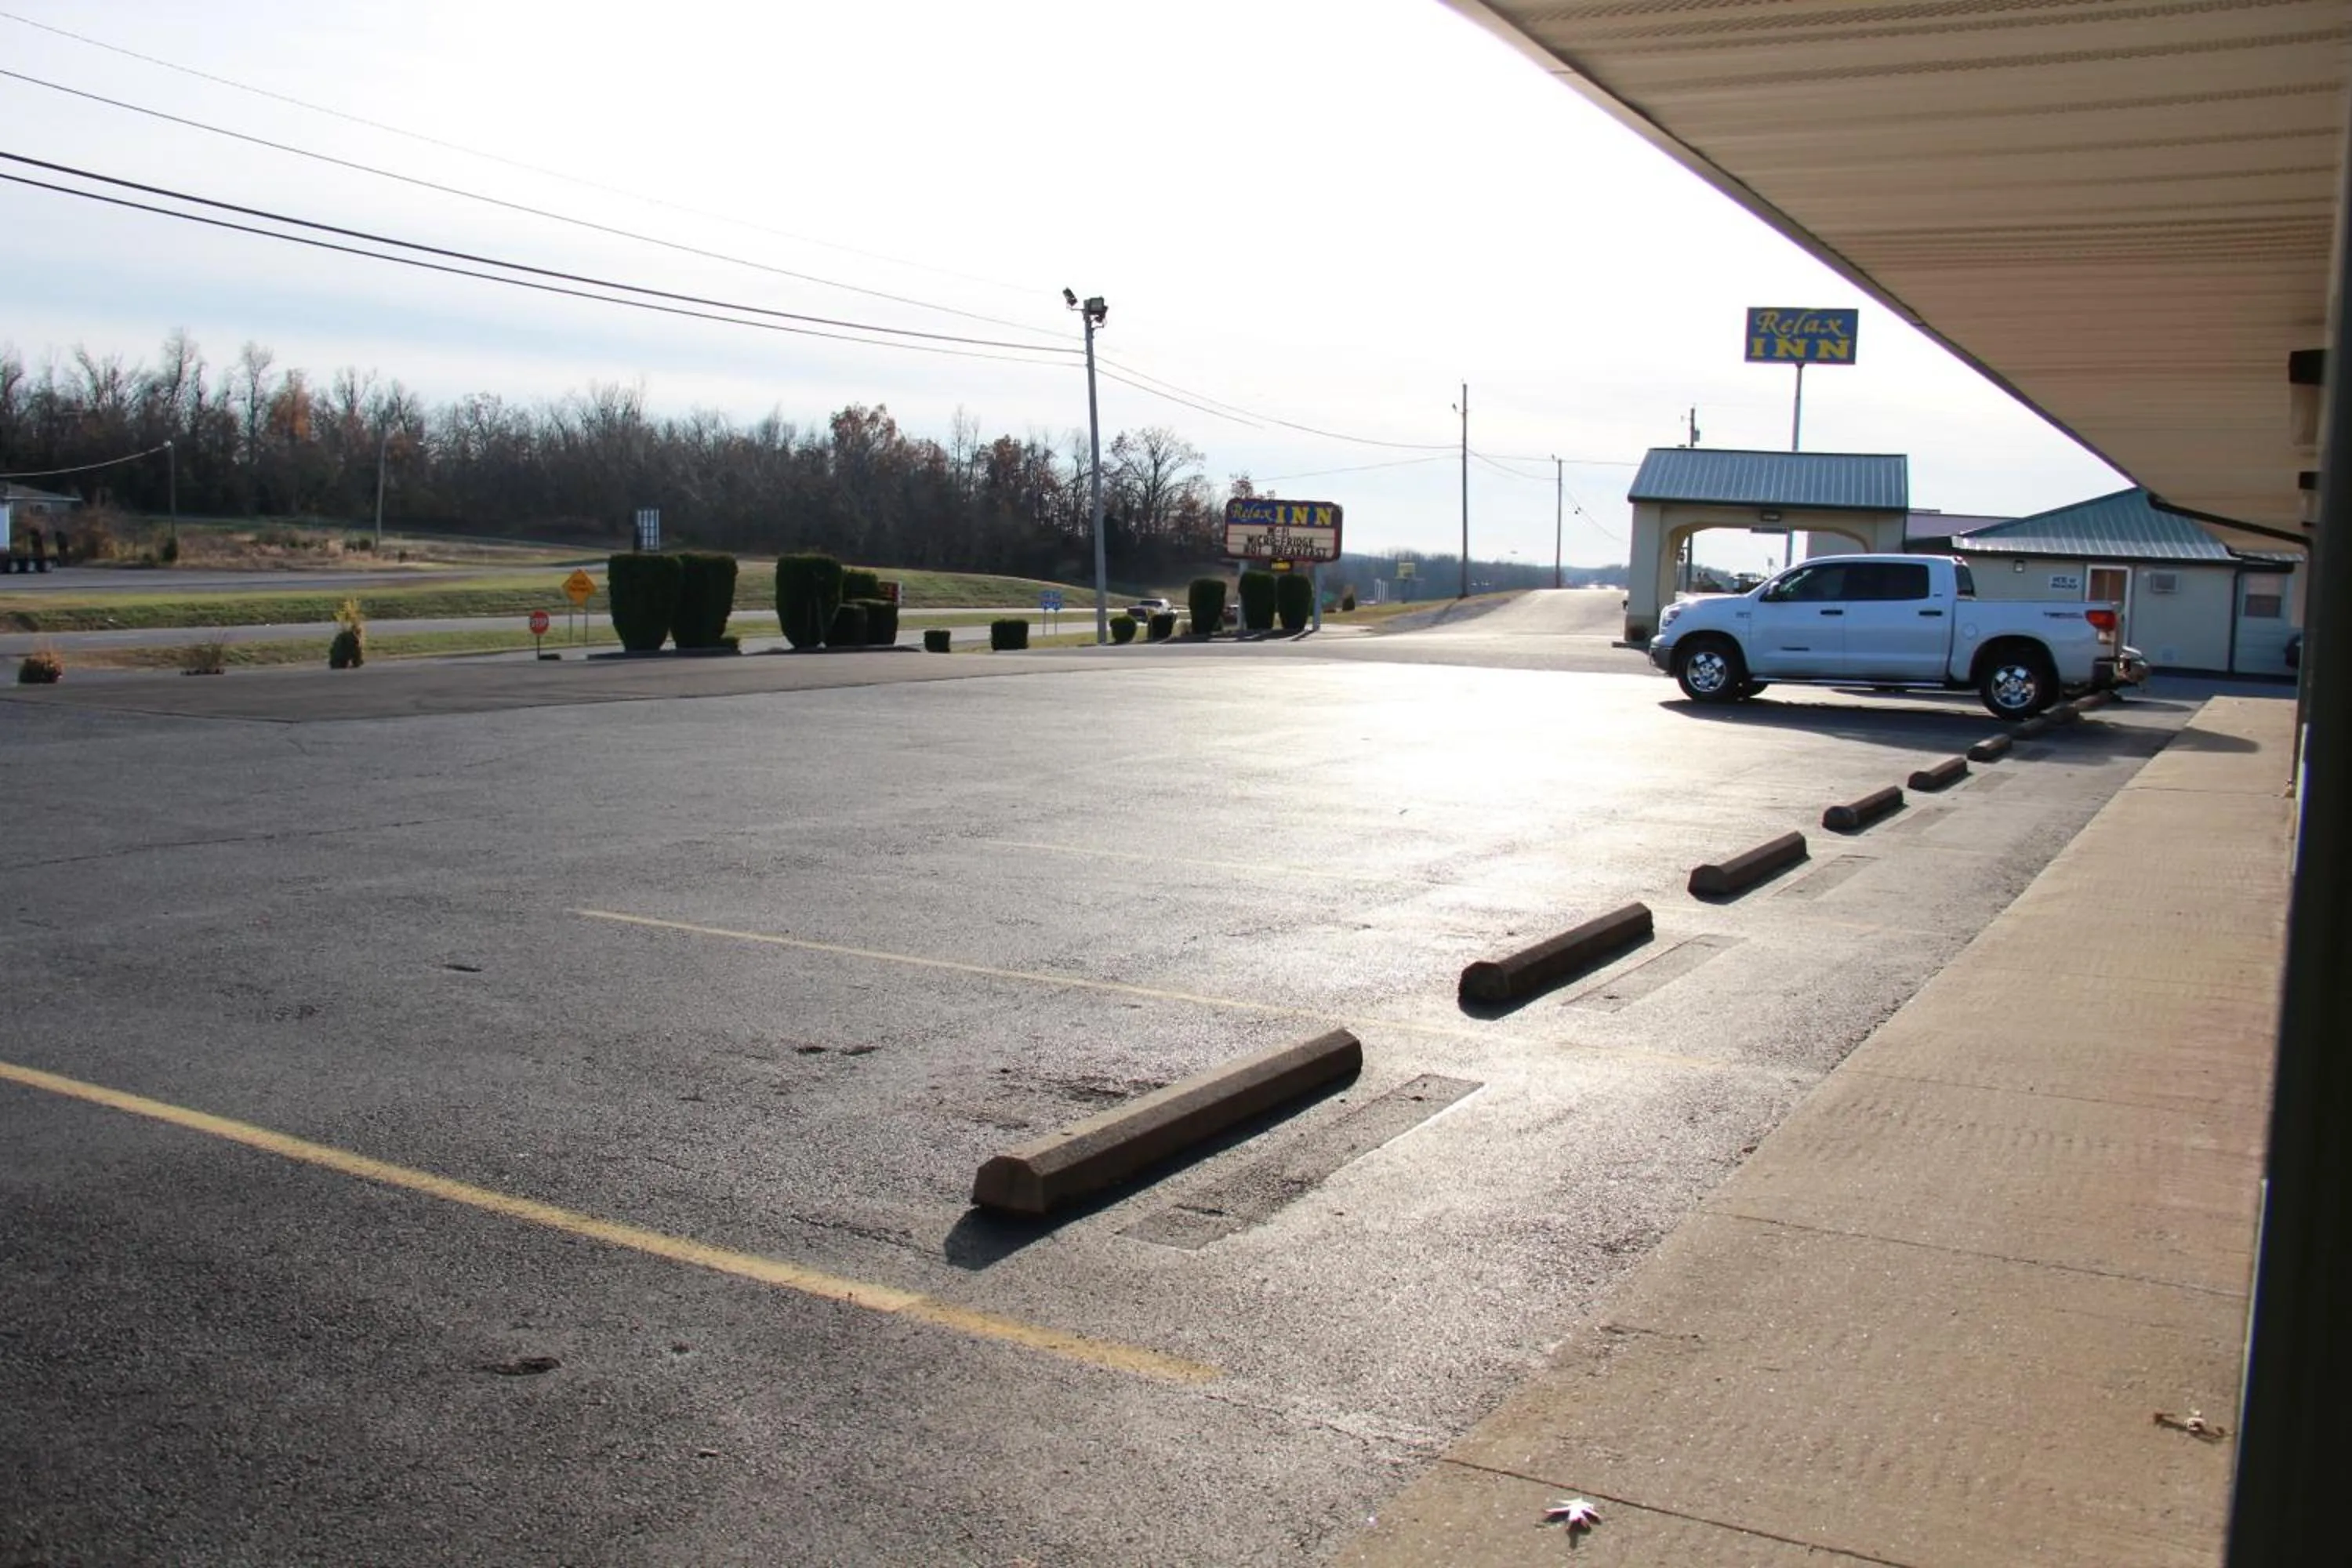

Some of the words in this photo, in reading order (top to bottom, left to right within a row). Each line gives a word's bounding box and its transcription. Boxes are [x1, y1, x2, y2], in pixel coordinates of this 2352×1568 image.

[1755, 310, 1849, 339] Relax
[1751, 337, 1850, 359] INN
[1232, 503, 1274, 523] Relax
[1275, 504, 1332, 526] INN
[529, 616, 549, 628] STOP
